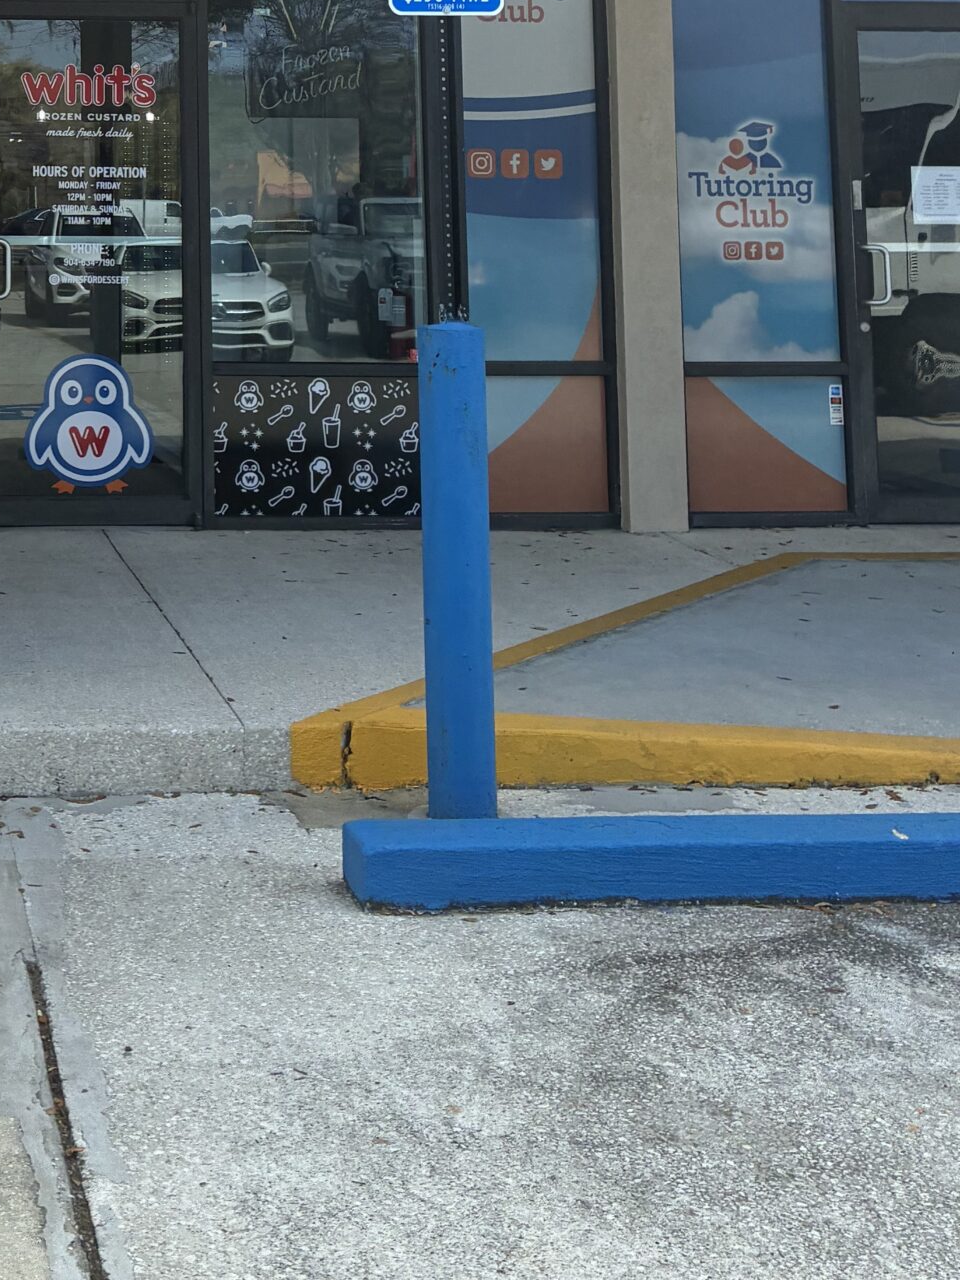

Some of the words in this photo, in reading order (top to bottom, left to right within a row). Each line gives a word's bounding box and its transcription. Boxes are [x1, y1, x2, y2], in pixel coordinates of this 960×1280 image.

[281, 43, 351, 74] Frozen
[20, 61, 157, 108] whit's
[258, 61, 363, 110] Custard
[87, 112, 141, 122] CUSTARD
[46, 126, 75, 137] made
[75, 126, 104, 139] fresh
[104, 126, 134, 141] daily
[32, 165, 68, 178] HOURS
[71, 165, 86, 178] OF
[89, 166, 147, 178] OPERATION
[58, 181, 89, 190] MONDAY
[96, 181, 121, 190] FRIDAY
[688, 171, 814, 204] Tutoring
[67, 193, 86, 201] 12PM
[93, 193, 112, 202] 10PM
[52, 204, 89, 213] SATURDAY
[99, 205, 127, 214] SUNDA
[715, 198, 789, 228] Club
[92, 216, 112, 226] 10PM
[70, 243, 110, 255] PHONE:
[244, 396, 255, 406] W
[357, 396, 368, 406] W
[68, 425, 110, 459] W
[245, 475, 256, 484] W
[358, 475, 369, 484] W
